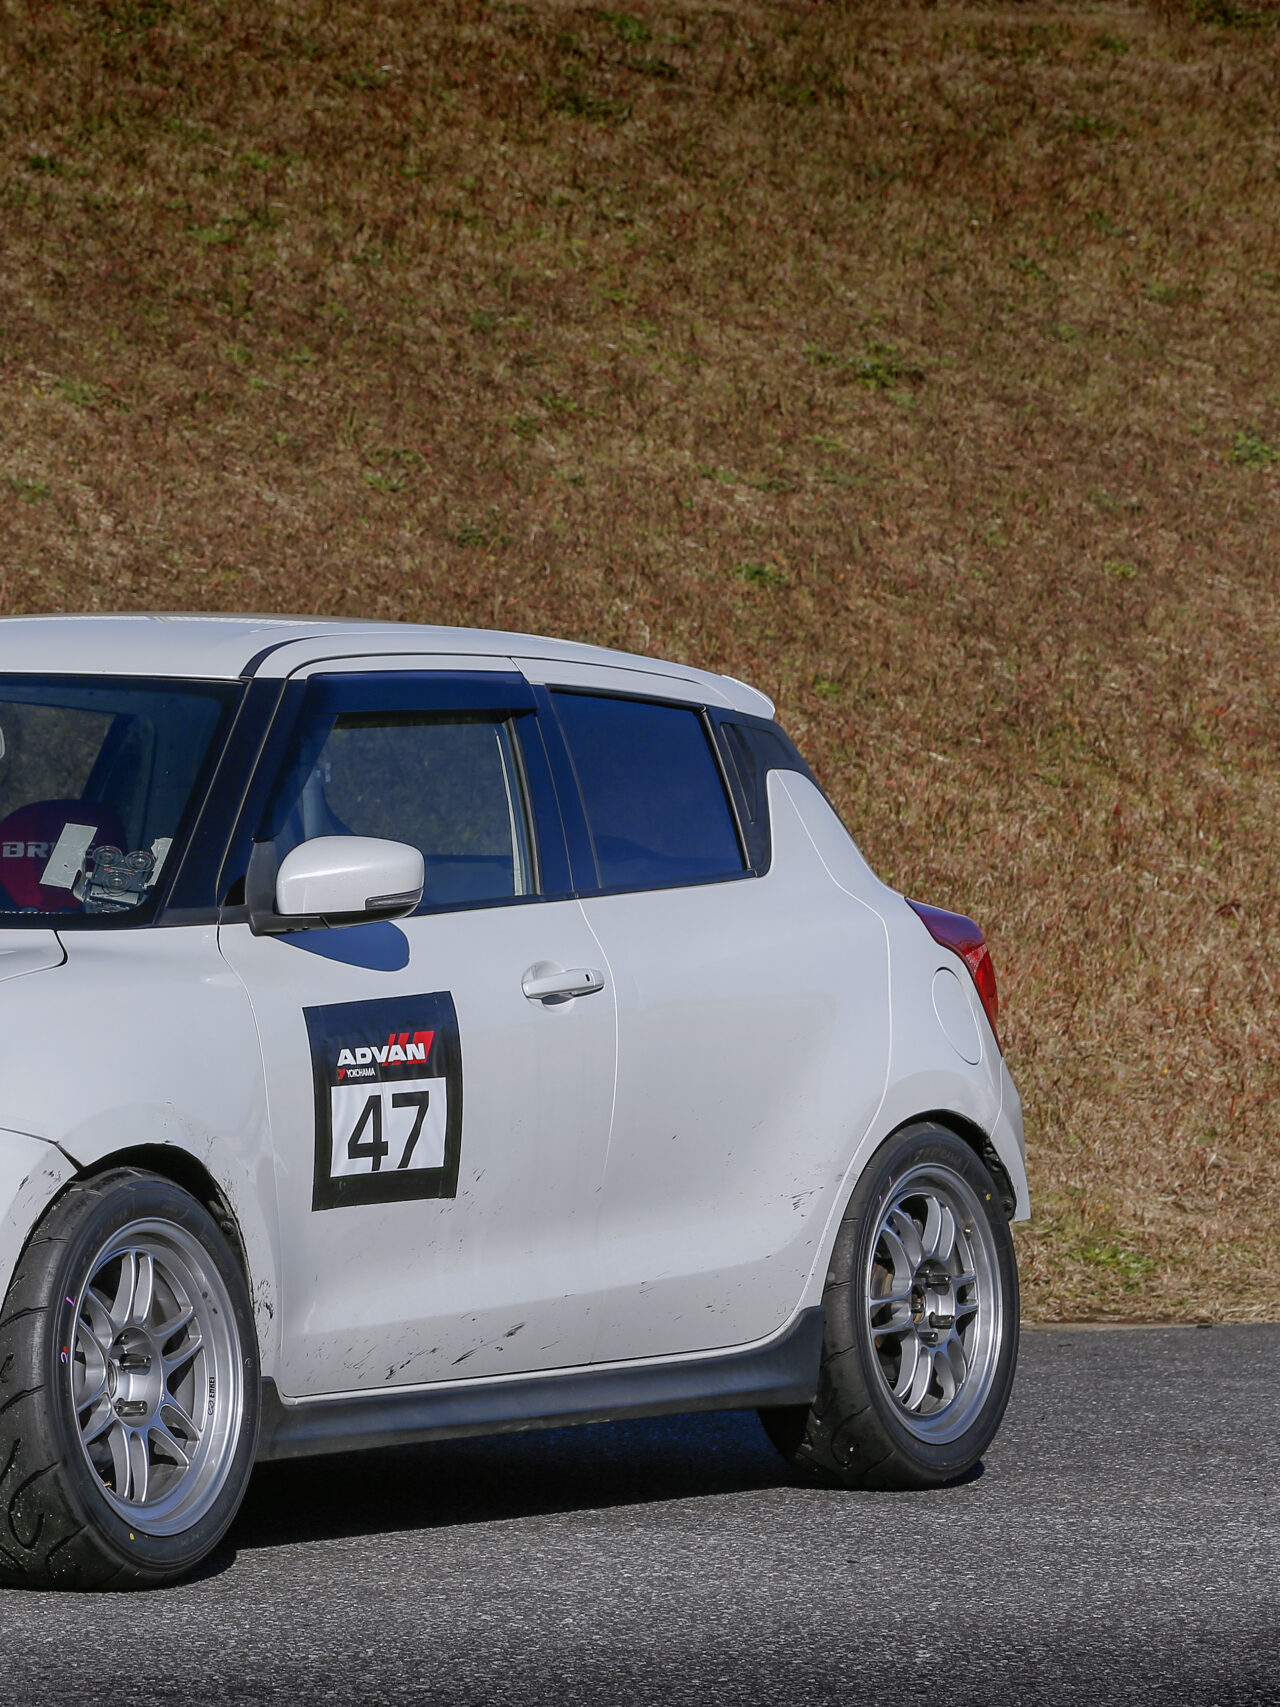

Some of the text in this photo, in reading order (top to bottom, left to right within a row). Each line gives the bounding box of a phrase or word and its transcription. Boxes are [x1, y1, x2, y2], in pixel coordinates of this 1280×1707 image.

[337, 1043, 426, 1066] ADVAN
[346, 1067, 376, 1078] YOKOHAMA
[348, 1090, 429, 1172] 47
